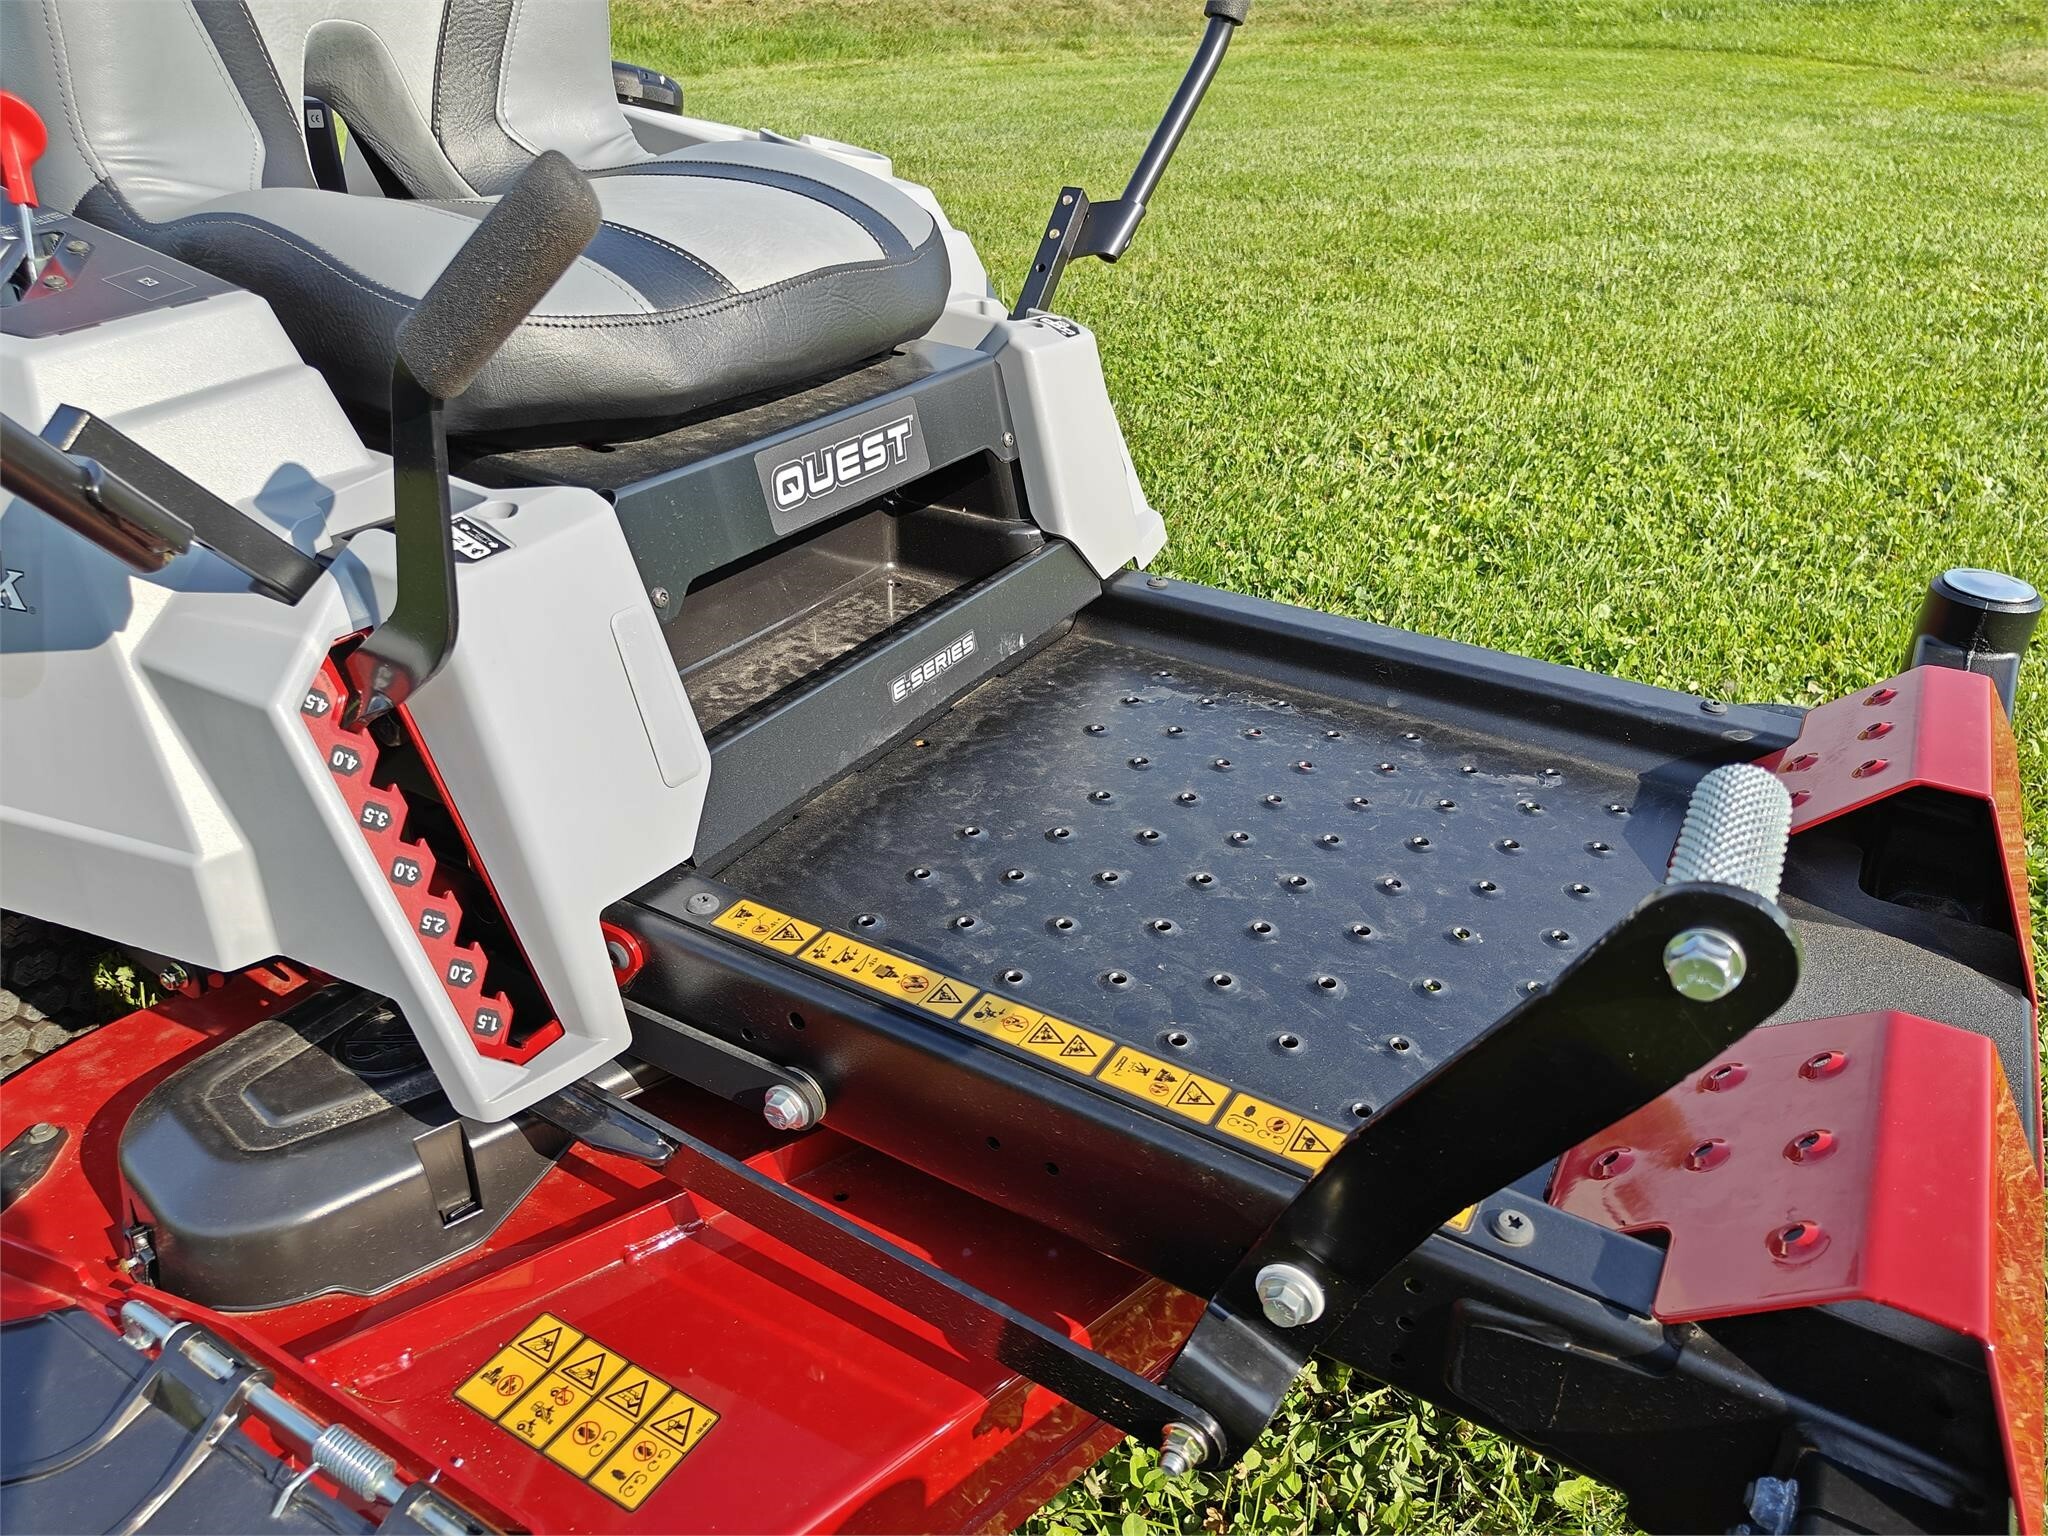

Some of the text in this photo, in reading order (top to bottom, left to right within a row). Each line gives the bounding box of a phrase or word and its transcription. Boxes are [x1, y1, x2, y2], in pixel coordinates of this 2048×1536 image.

[772, 416, 912, 511] QUEST
[892, 631, 975, 702] E-SERIES
[304, 694, 329, 713] 4.5
[332, 750, 358, 770] 4.0
[363, 807, 389, 827] 3.5
[394, 862, 418, 881] 3.0
[421, 914, 446, 933] 2.5
[449, 965, 473, 983] 2.0
[477, 1014, 498, 1032] 1.5
